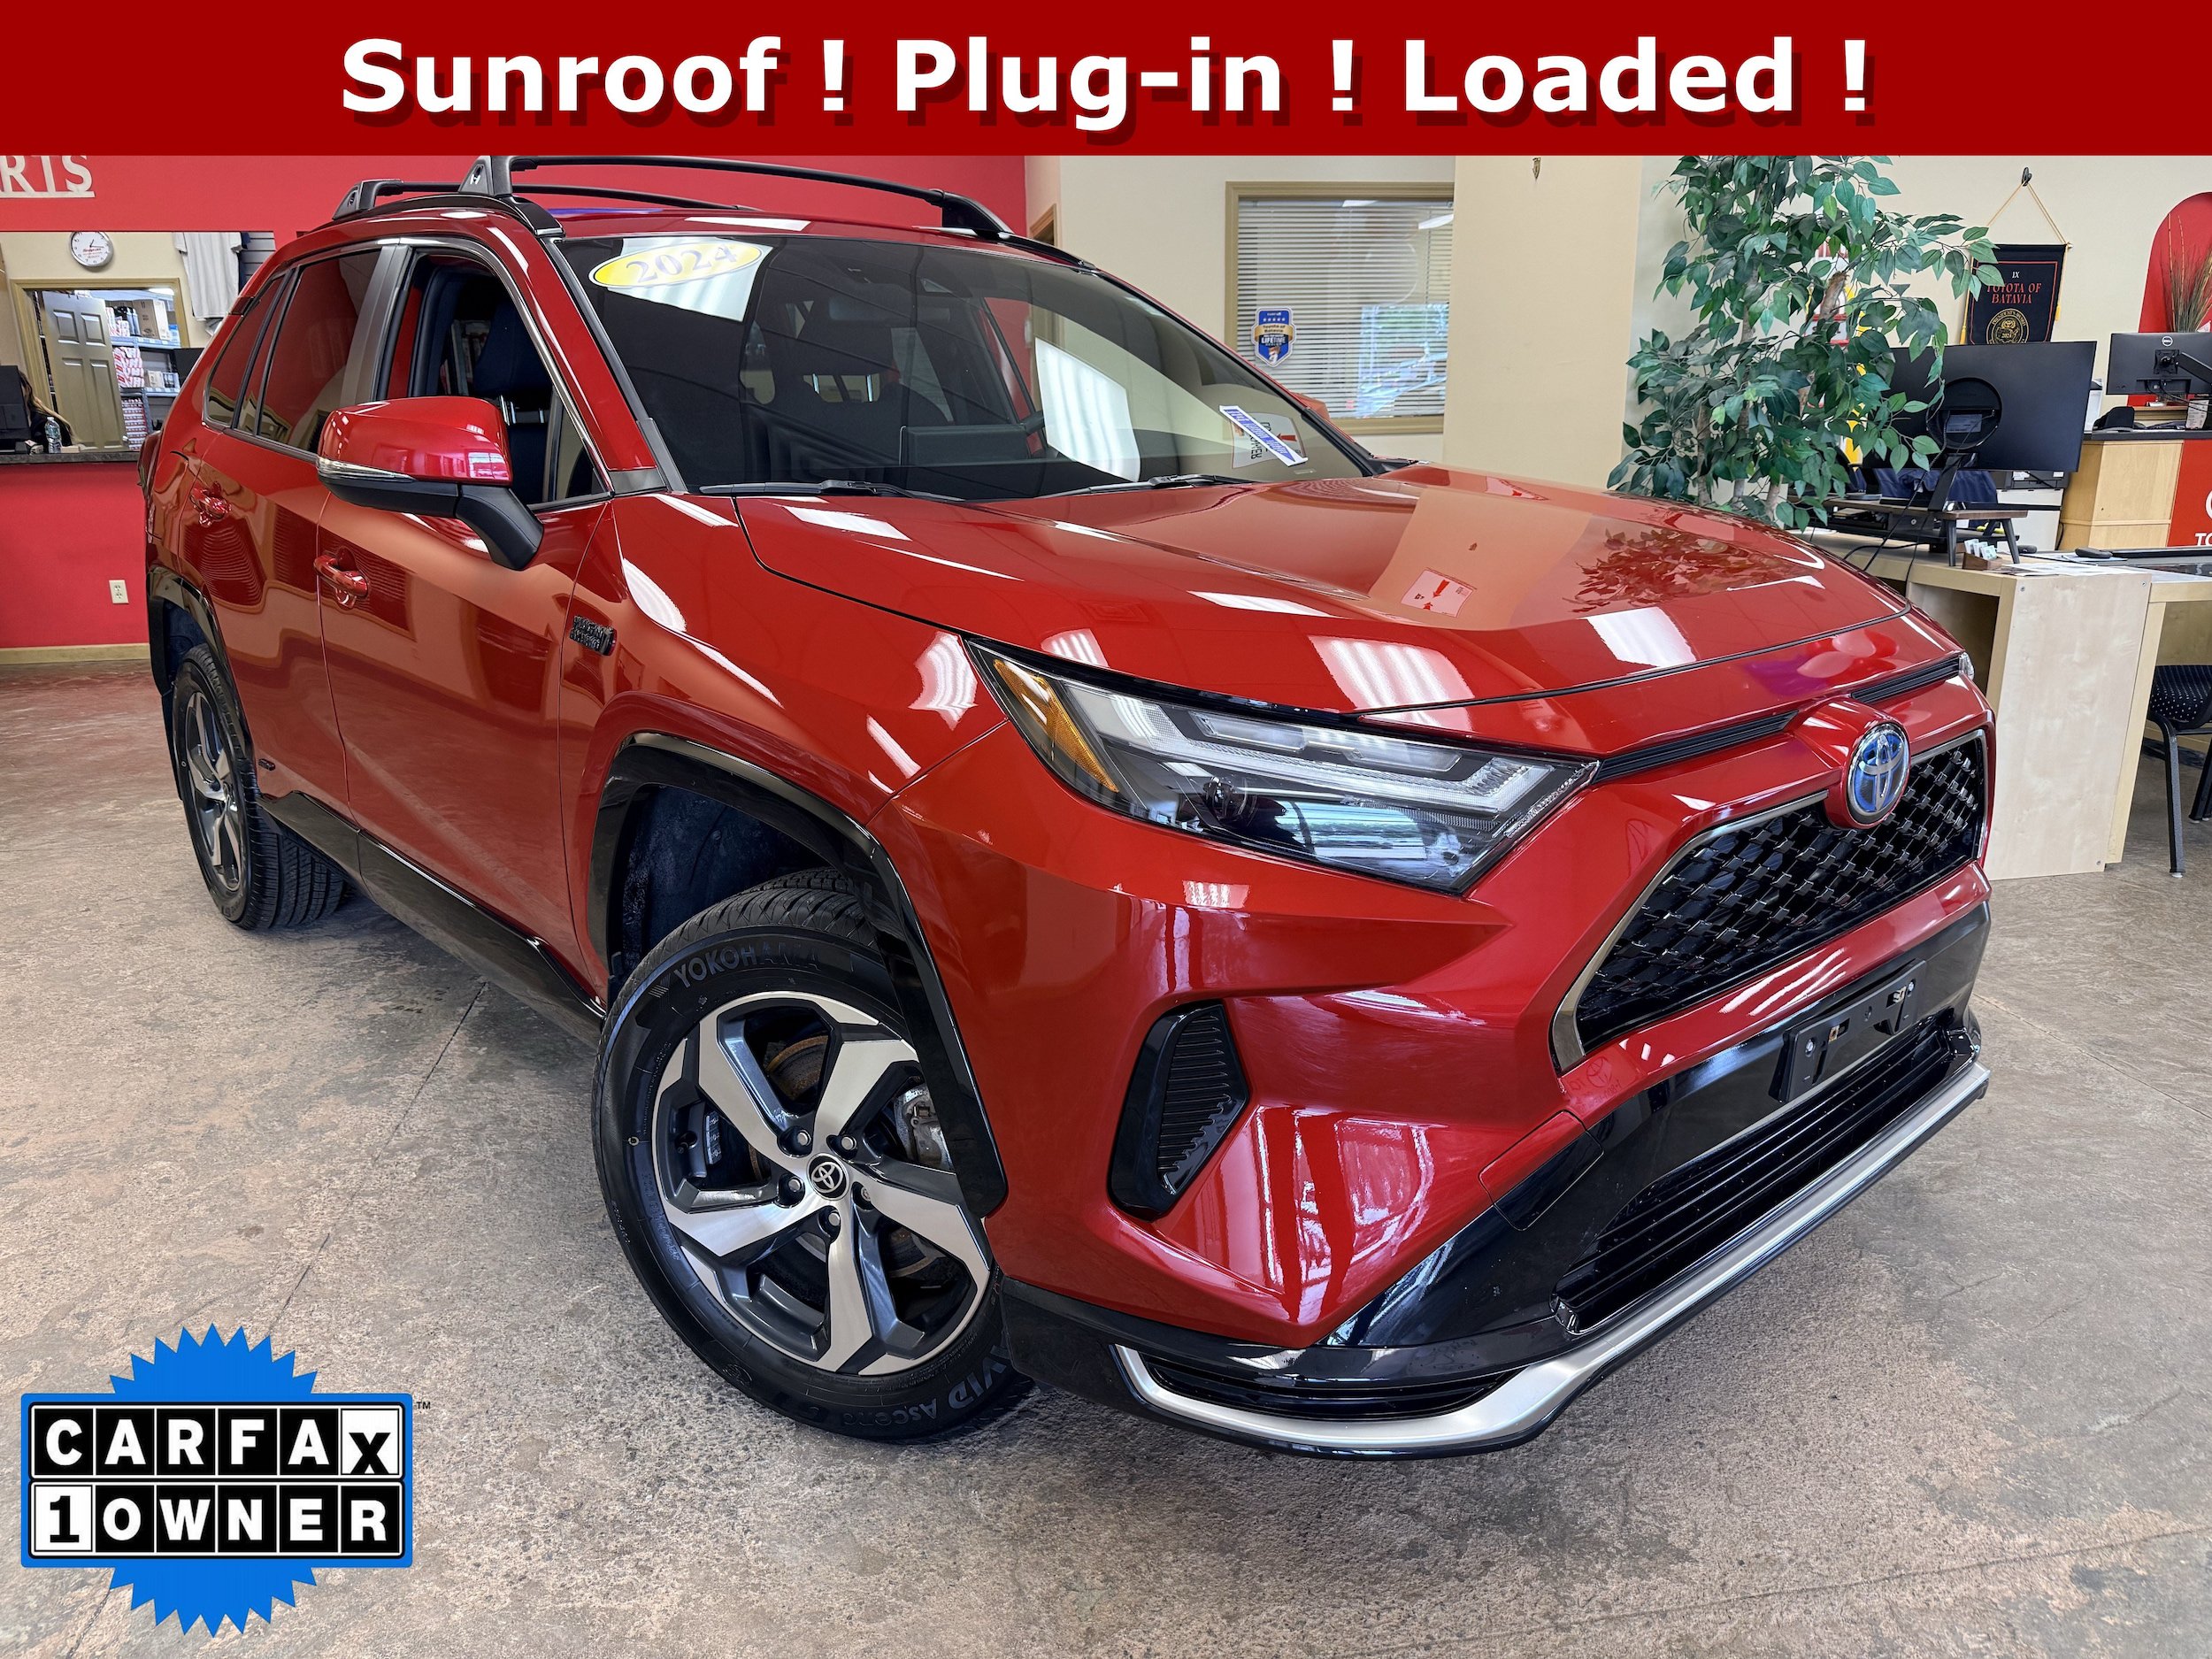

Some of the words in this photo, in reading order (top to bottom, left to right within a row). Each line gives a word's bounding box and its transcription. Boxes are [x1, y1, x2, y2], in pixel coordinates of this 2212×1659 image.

[626, 243, 738, 283] 2024
[2028, 282, 2042, 293] OF
[1991, 293, 2032, 304] BATAVIA
